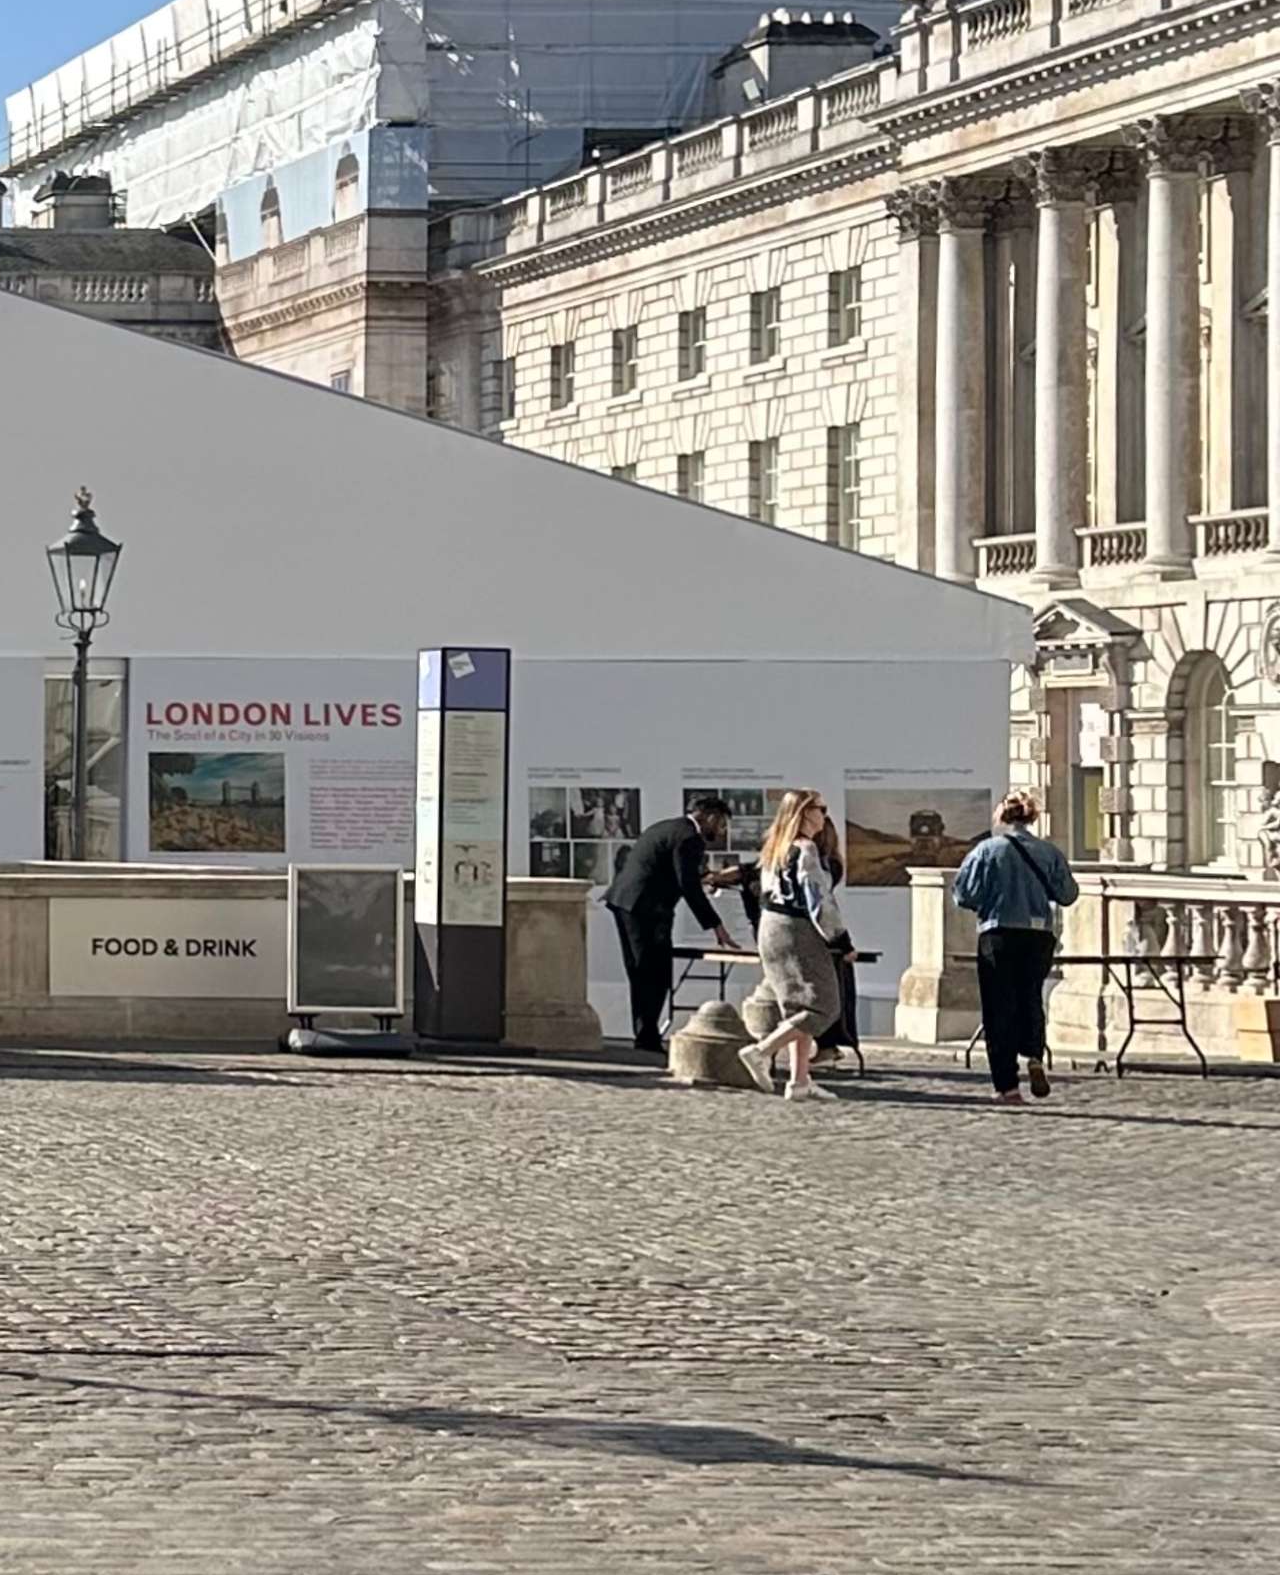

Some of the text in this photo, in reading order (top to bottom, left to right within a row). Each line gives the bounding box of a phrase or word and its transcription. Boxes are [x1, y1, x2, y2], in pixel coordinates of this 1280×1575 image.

[146, 702, 403, 727] LONDON LIVES
[148, 729, 171, 741] The
[173, 729, 202, 741] Soul
[204, 729, 217, 741] of
[218, 732, 226, 741] a
[228, 729, 252, 744] City
[255, 729, 267, 741] in
[285, 729, 331, 742] Visions
[91, 938, 258, 957] FOOD & DRINK
